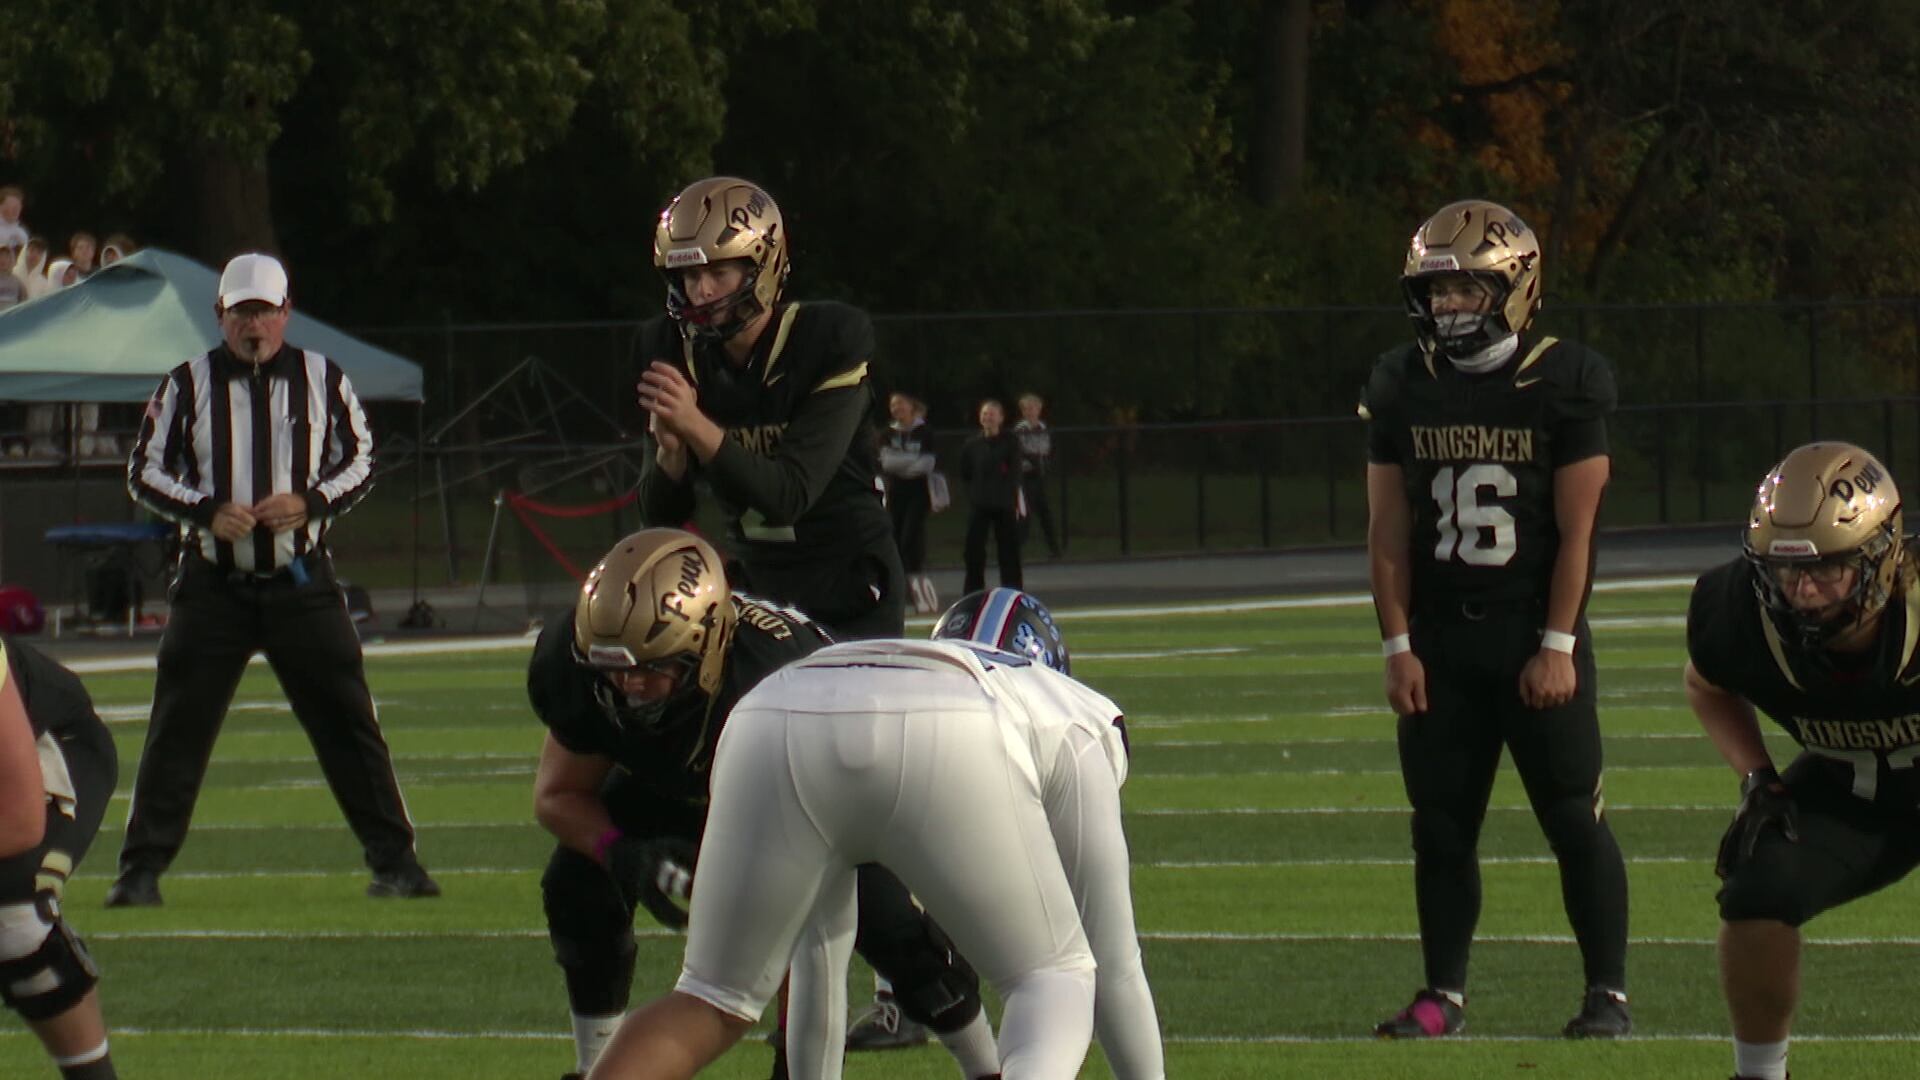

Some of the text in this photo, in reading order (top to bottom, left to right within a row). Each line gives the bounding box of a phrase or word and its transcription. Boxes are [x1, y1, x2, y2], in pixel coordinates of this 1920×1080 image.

[667, 251, 700, 263] Riddell
[1410, 425, 1534, 462] KINGSMEN
[1431, 464, 1518, 566] 16
[1793, 714, 1920, 749] KINGSME
